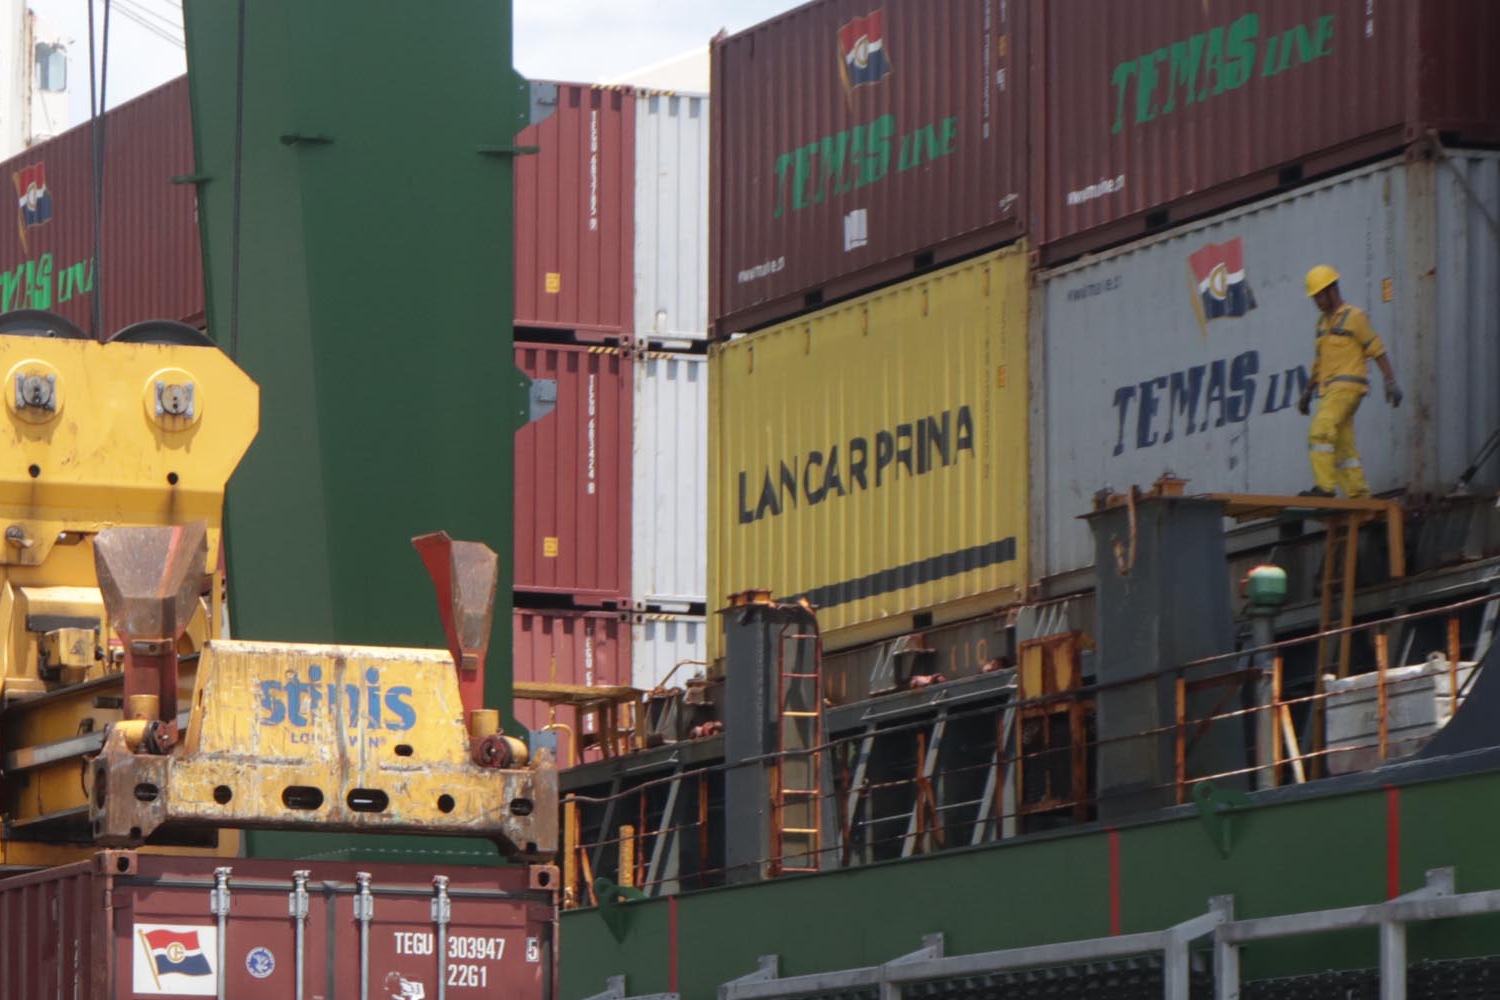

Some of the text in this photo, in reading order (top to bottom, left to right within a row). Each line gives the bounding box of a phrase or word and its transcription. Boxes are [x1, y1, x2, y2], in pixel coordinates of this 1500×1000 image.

[1111, 12, 1260, 135] TEMAS
[1112, 350, 1260, 457] TEMAS
[393, 931, 538, 961] TEGU 303947 5
[448, 964, 487, 988] 22G1
